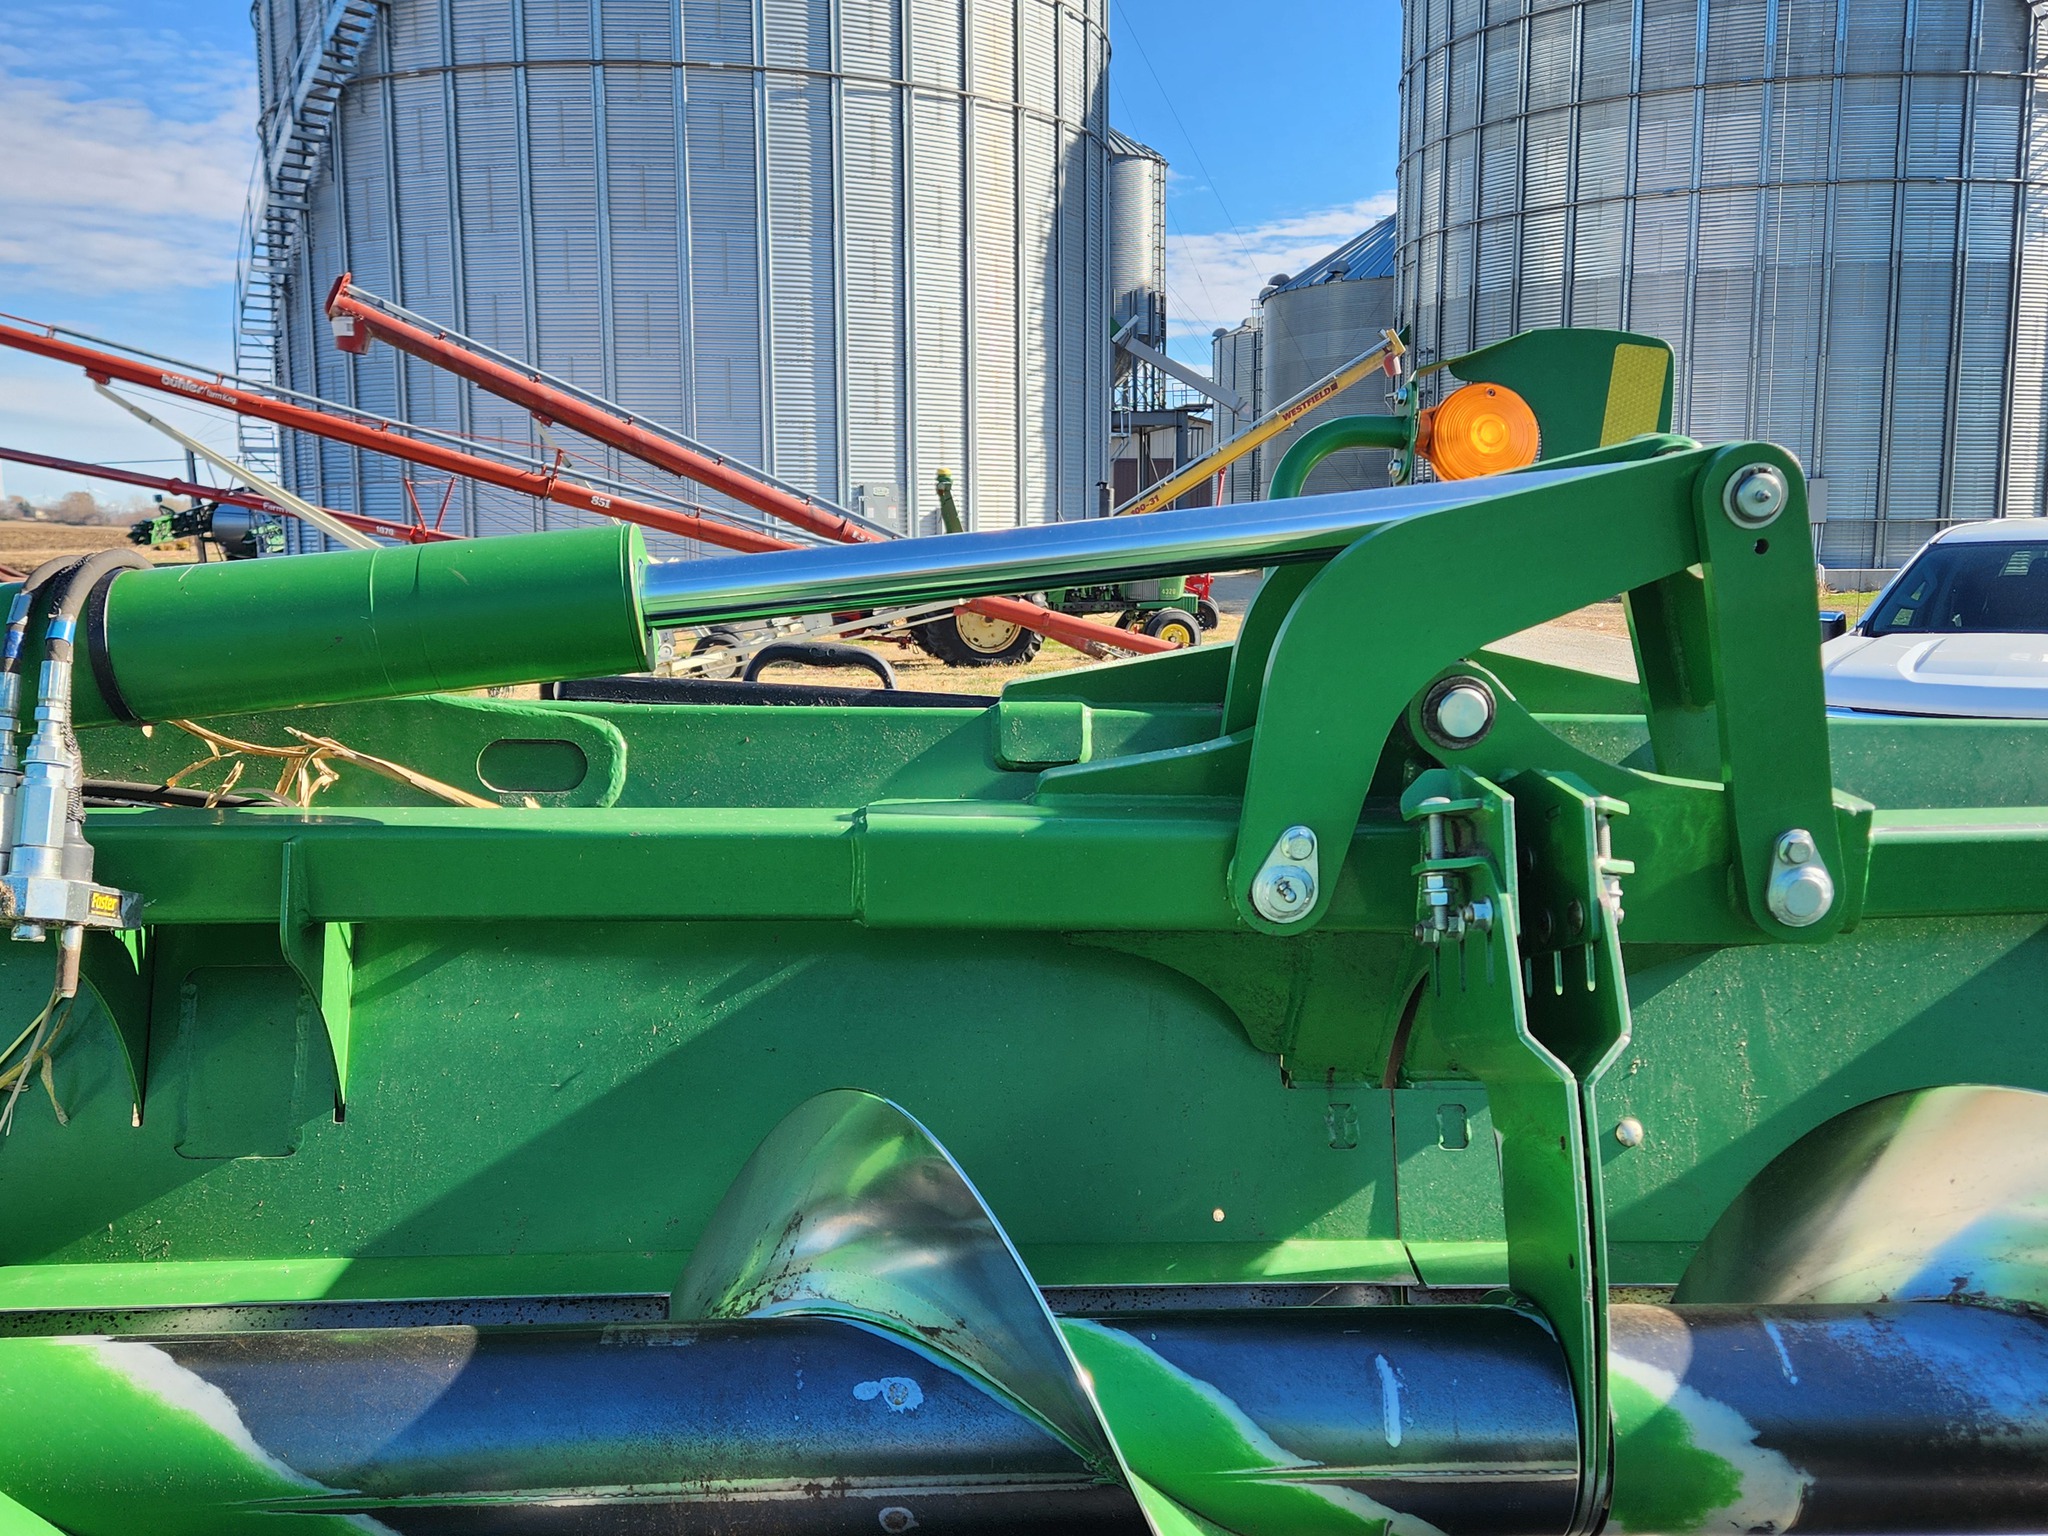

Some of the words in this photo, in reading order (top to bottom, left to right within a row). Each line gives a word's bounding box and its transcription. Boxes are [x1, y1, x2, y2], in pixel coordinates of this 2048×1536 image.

[1282, 387, 1331, 421] WESTFIELD
[262, 501, 286, 514] Farm
[590, 495, 611, 509] 851
